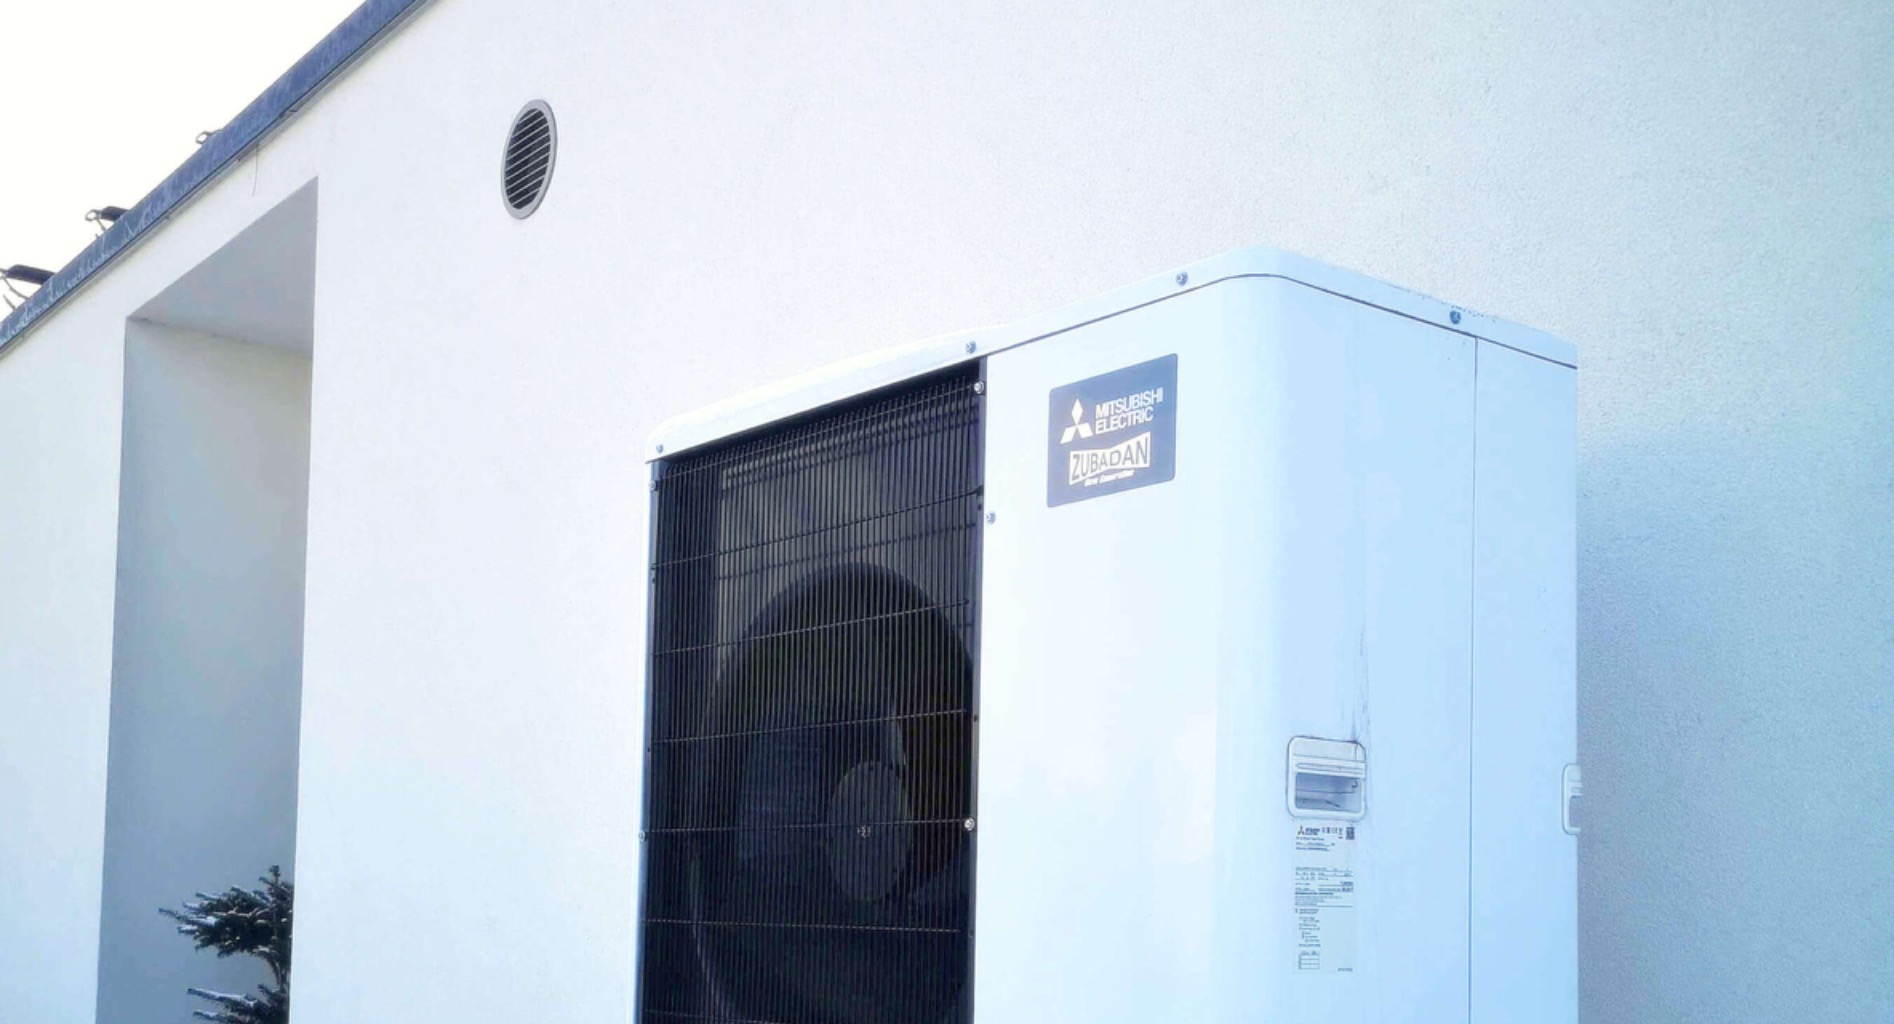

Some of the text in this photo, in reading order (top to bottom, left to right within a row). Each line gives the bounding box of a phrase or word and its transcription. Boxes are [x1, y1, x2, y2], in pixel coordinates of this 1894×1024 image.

[1095, 387, 1163, 420] MITSUBISHI
[1095, 406, 1154, 435] ELECTRIC
[1071, 437, 1149, 482] ZUBADAN
